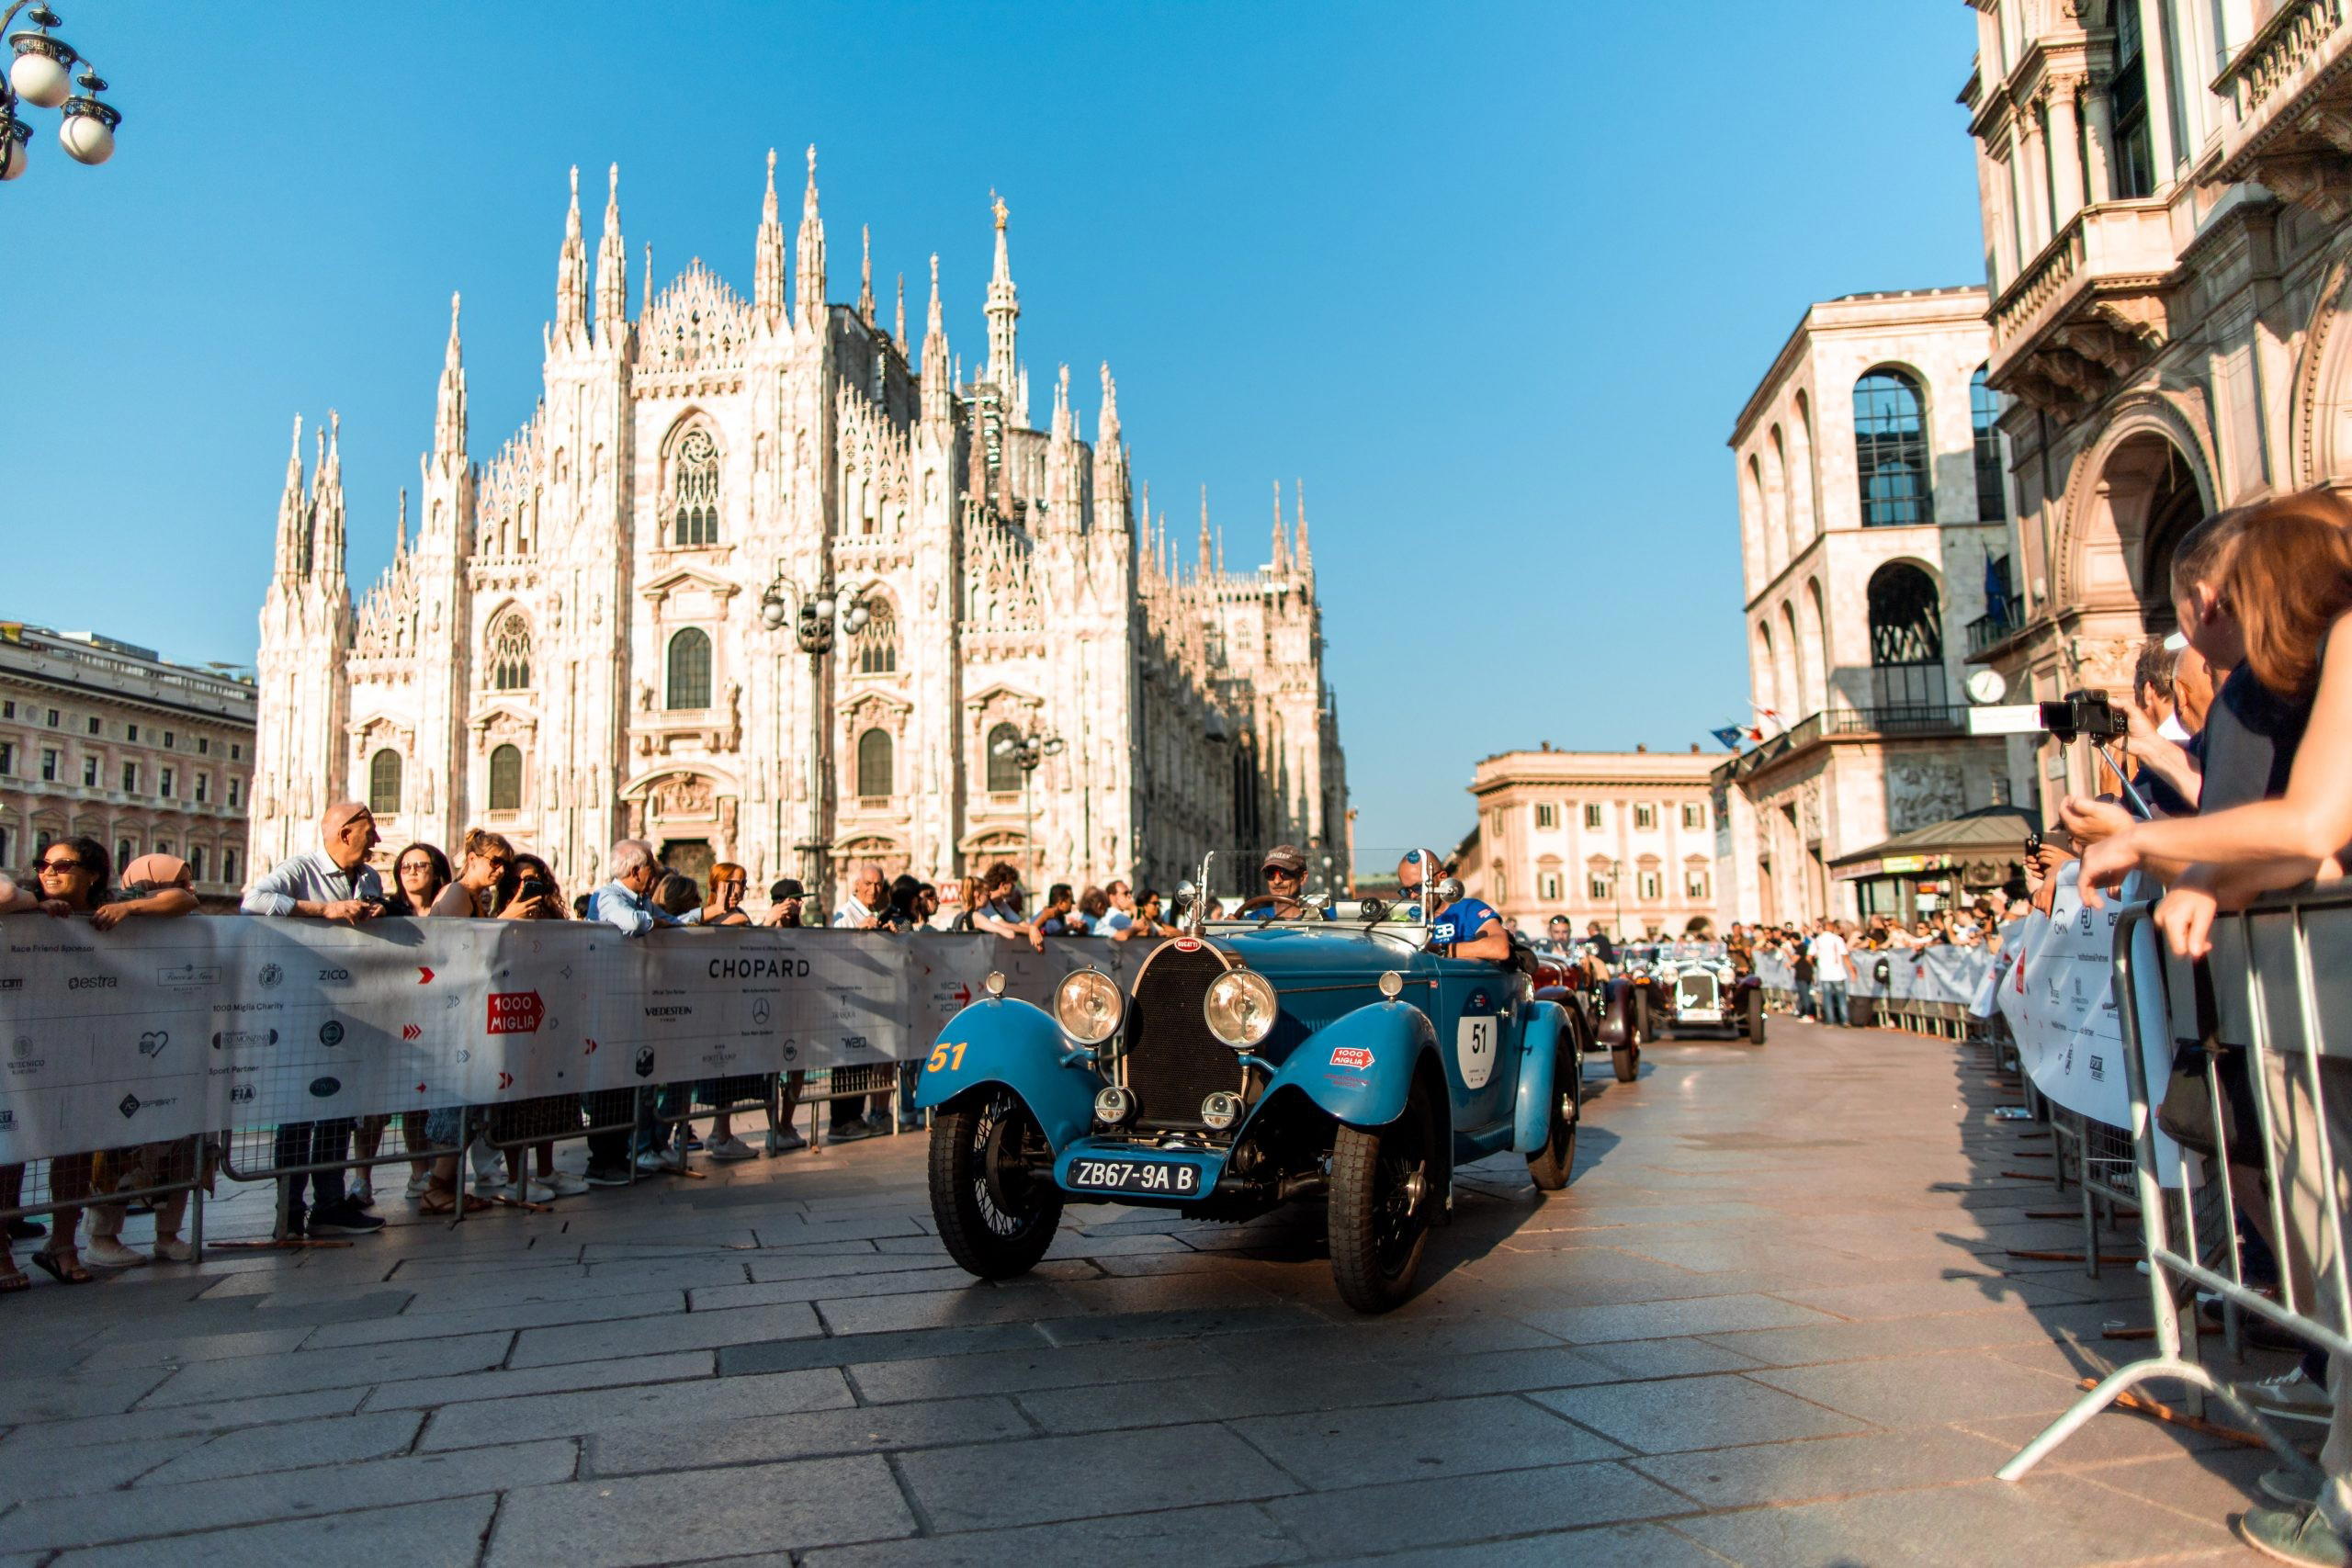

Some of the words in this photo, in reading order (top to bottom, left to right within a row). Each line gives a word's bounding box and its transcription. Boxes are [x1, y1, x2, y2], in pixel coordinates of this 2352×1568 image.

[11, 945, 31, 953] Race
[32, 944, 59, 953] Friend
[319, 969, 349, 981] ZICO
[708, 959, 810, 978] CHOPARD
[79, 975, 118, 989] estra
[256, 1001, 285, 1011] Charity
[494, 996, 532, 1011] 1000
[491, 1015, 535, 1031] MIGLIA
[1473, 1023, 1487, 1054] 51
[927, 1043, 968, 1073] 51
[1333, 1056, 1363, 1066] MIGLIA
[209, 1067, 230, 1077] Sport
[232, 1065, 259, 1074] Partner
[230, 1088, 254, 1101] FIA
[1078, 1162, 1170, 1190] ZB67-9A
[1177, 1167, 1193, 1190] B
